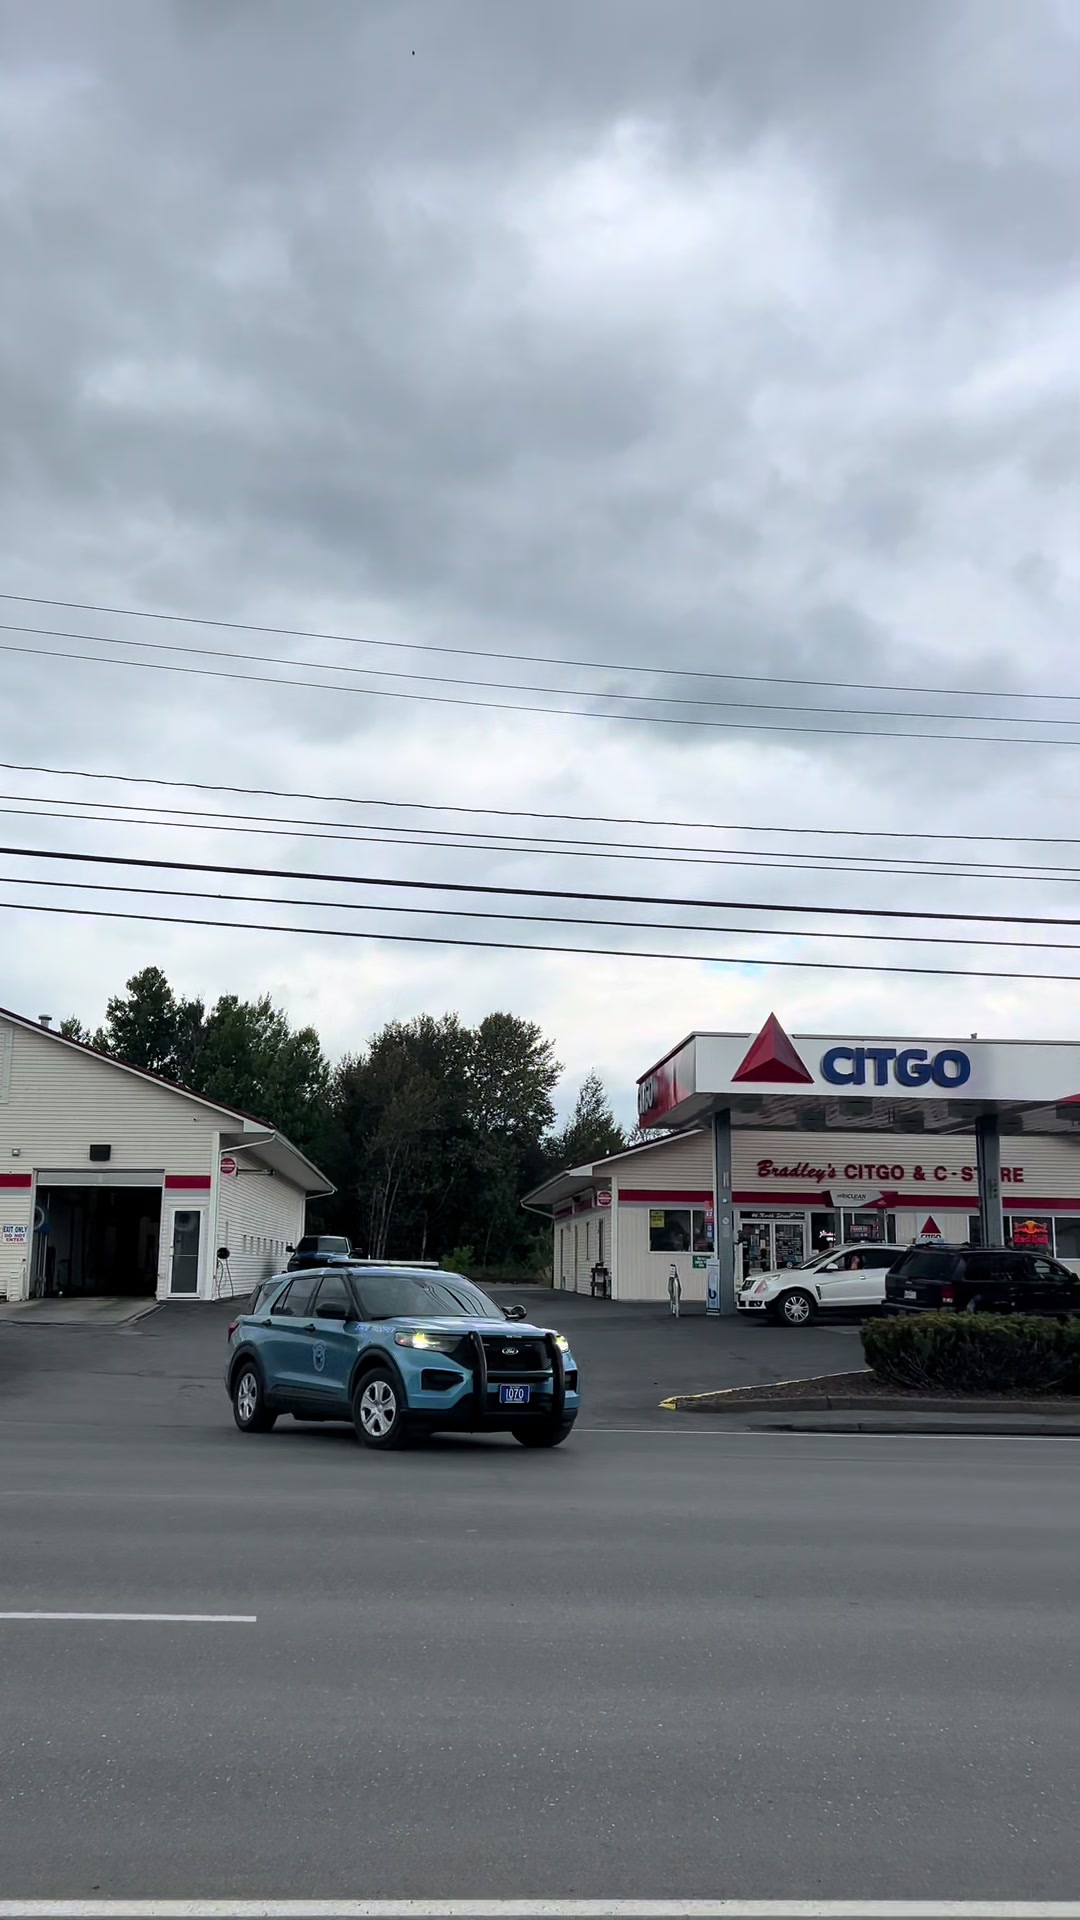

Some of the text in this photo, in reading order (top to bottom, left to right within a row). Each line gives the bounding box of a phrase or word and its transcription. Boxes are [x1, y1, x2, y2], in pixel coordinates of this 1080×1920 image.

[820, 1046, 971, 1088] CITGO
[757, 1159, 837, 1183] Bradley's
[844, 1164, 905, 1180] CITGO
[912, 1165, 926, 1181] &
[505, 1388, 525, 1399] 1070
